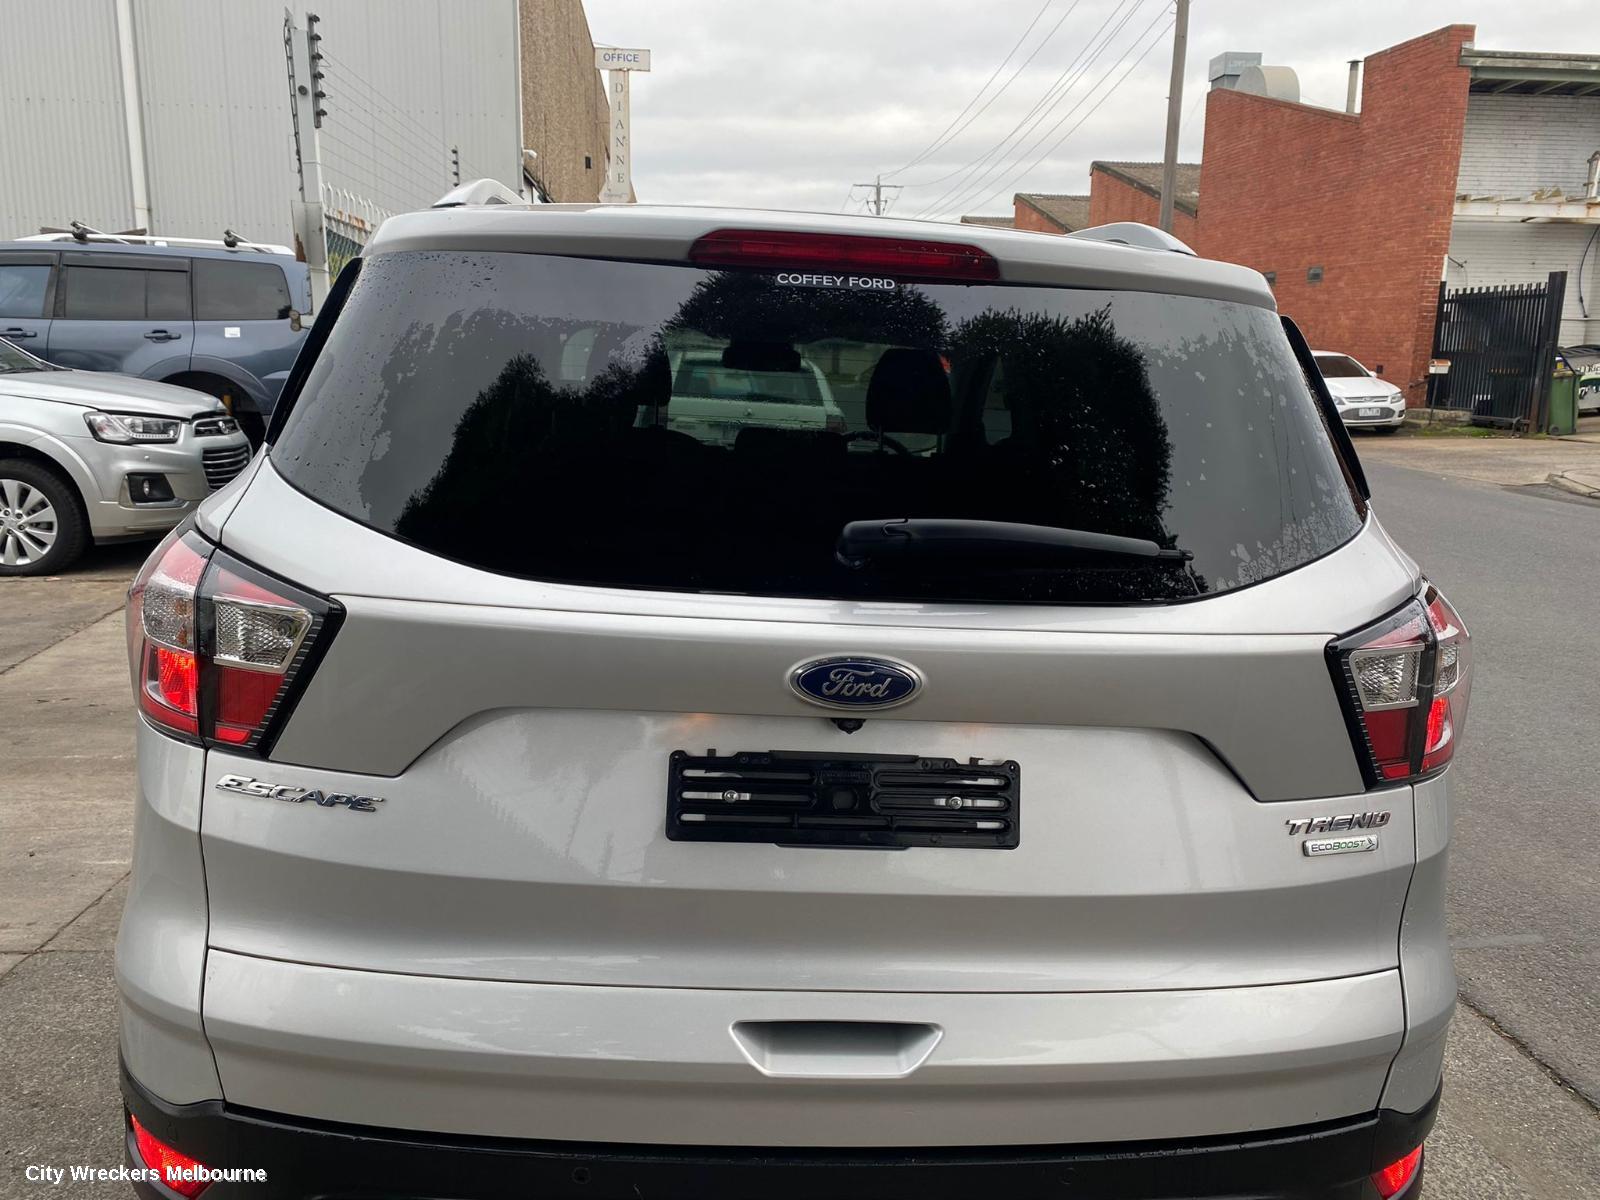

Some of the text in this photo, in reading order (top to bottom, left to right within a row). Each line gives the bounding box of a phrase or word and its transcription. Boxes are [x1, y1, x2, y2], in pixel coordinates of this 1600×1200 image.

[603, 53, 639, 63] OFFICE
[615, 82, 625, 184] DIANNE
[777, 273, 896, 289] COFFEY FORD
[822, 668, 893, 698] Ford
[216, 774, 385, 813] ESCAPE
[1285, 810, 1392, 836] TREND
